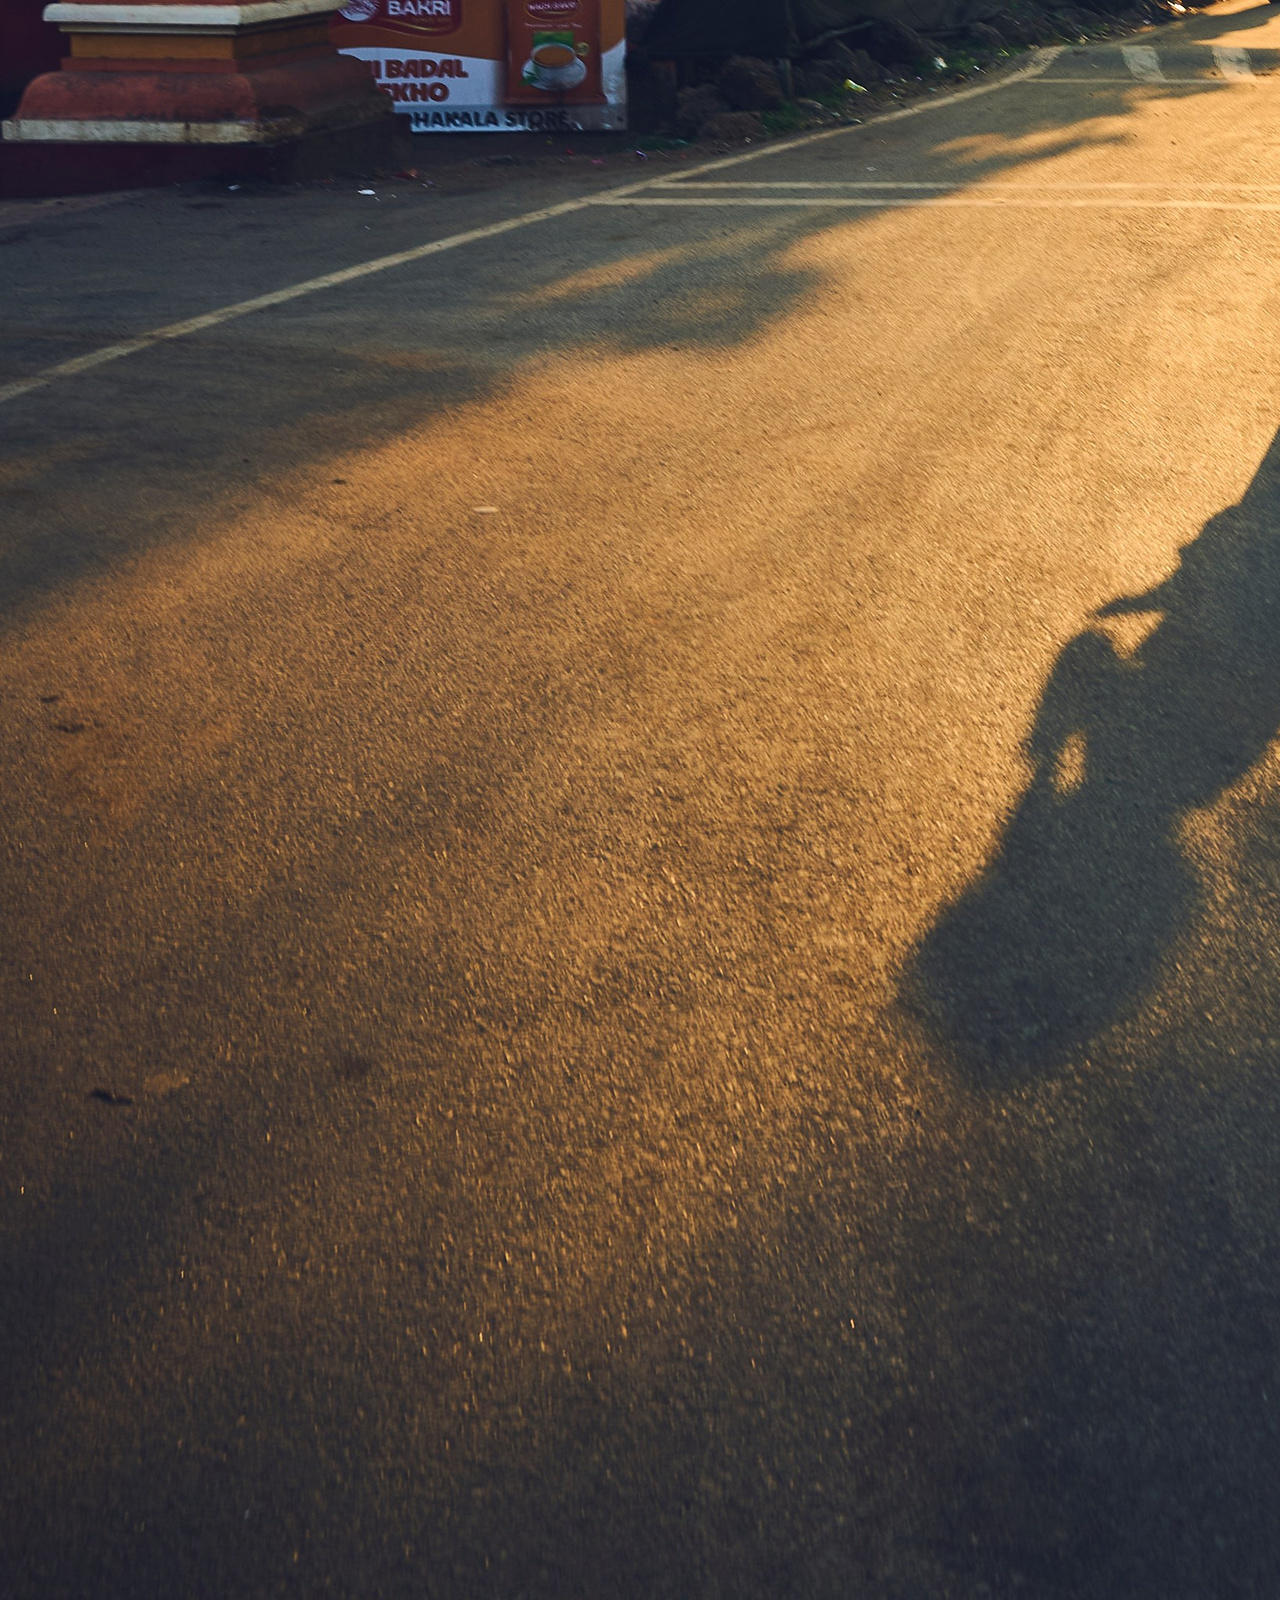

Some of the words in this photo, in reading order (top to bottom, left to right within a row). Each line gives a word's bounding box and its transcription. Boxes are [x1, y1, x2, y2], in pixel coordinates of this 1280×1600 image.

[387, 0, 452, 16] BAKRI
[385, 58, 469, 79] BADAL
[412, 110, 498, 129] HAKALA
